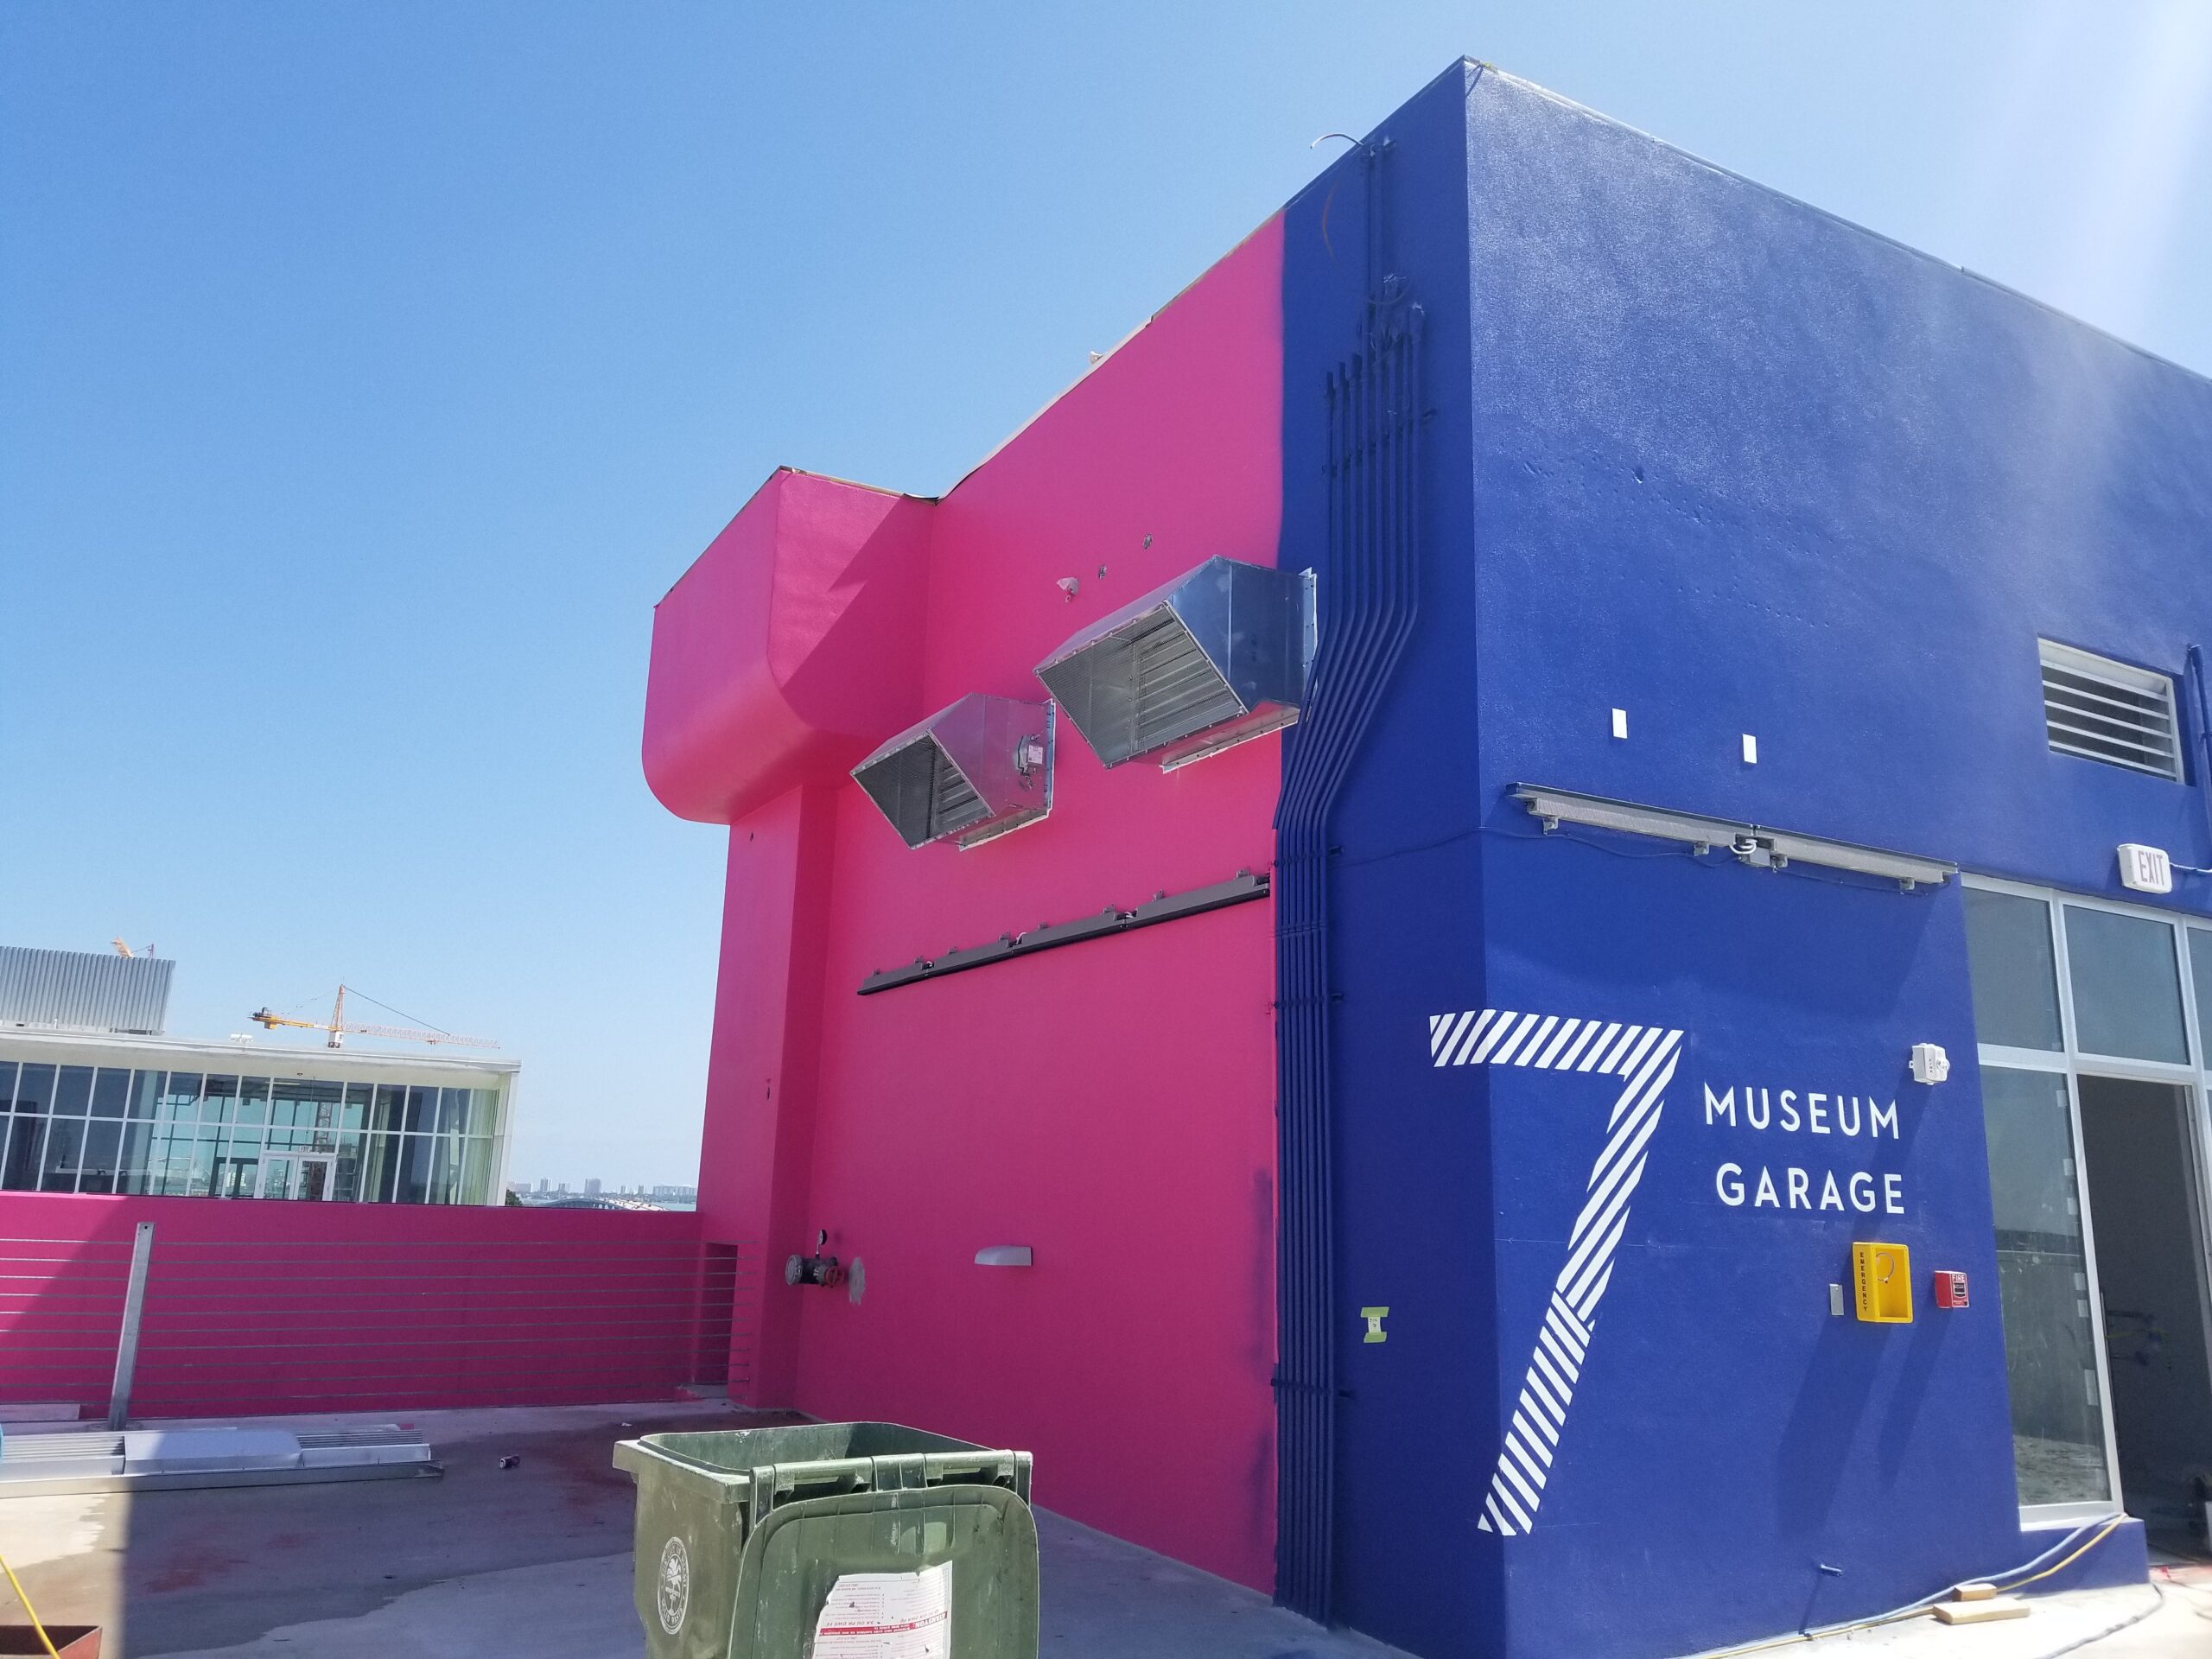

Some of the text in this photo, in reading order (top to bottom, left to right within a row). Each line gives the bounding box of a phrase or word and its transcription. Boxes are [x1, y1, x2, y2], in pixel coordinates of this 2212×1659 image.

[2138, 850, 2164, 885] EXIT
[1705, 1083, 1898, 1139] MUSEUM
[1717, 1163, 1904, 1213] GARAGE
[1430, 1009, 1684, 1535] 7
[1952, 1274, 1966, 1282] FIRE
